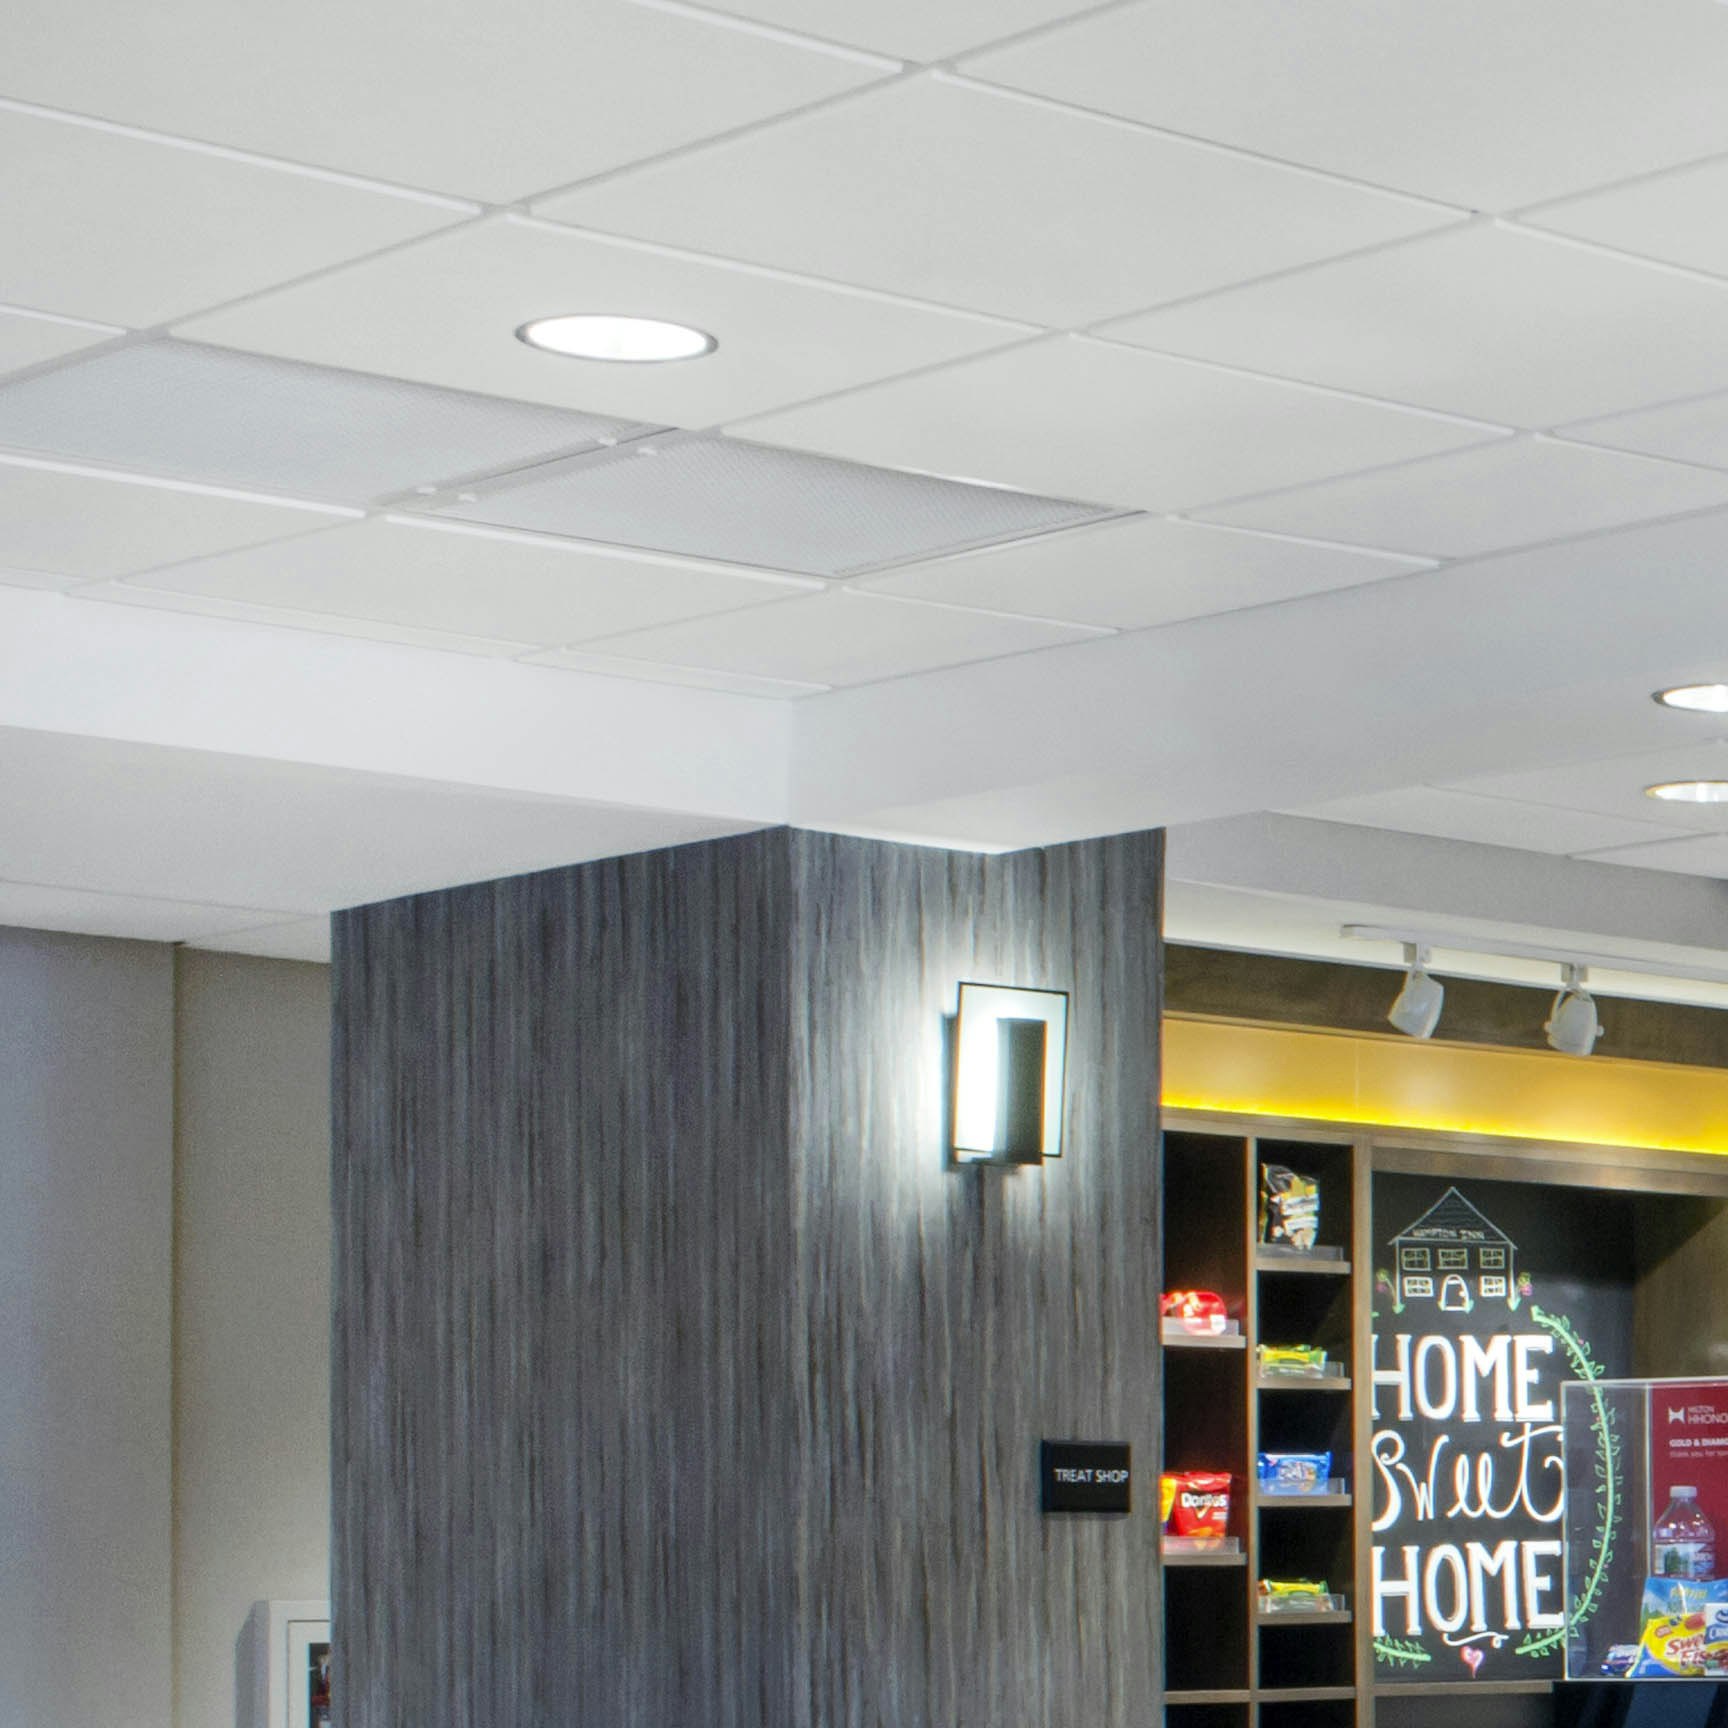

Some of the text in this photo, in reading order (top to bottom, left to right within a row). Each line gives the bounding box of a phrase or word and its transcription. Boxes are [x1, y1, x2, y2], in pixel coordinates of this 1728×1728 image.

[1372, 1334, 1553, 1422] HOME
[1054, 1468, 1129, 1483] TREAT SHOP
[1181, 1492, 1228, 1508] Doritos
[1372, 1540, 1564, 1636] HOME
